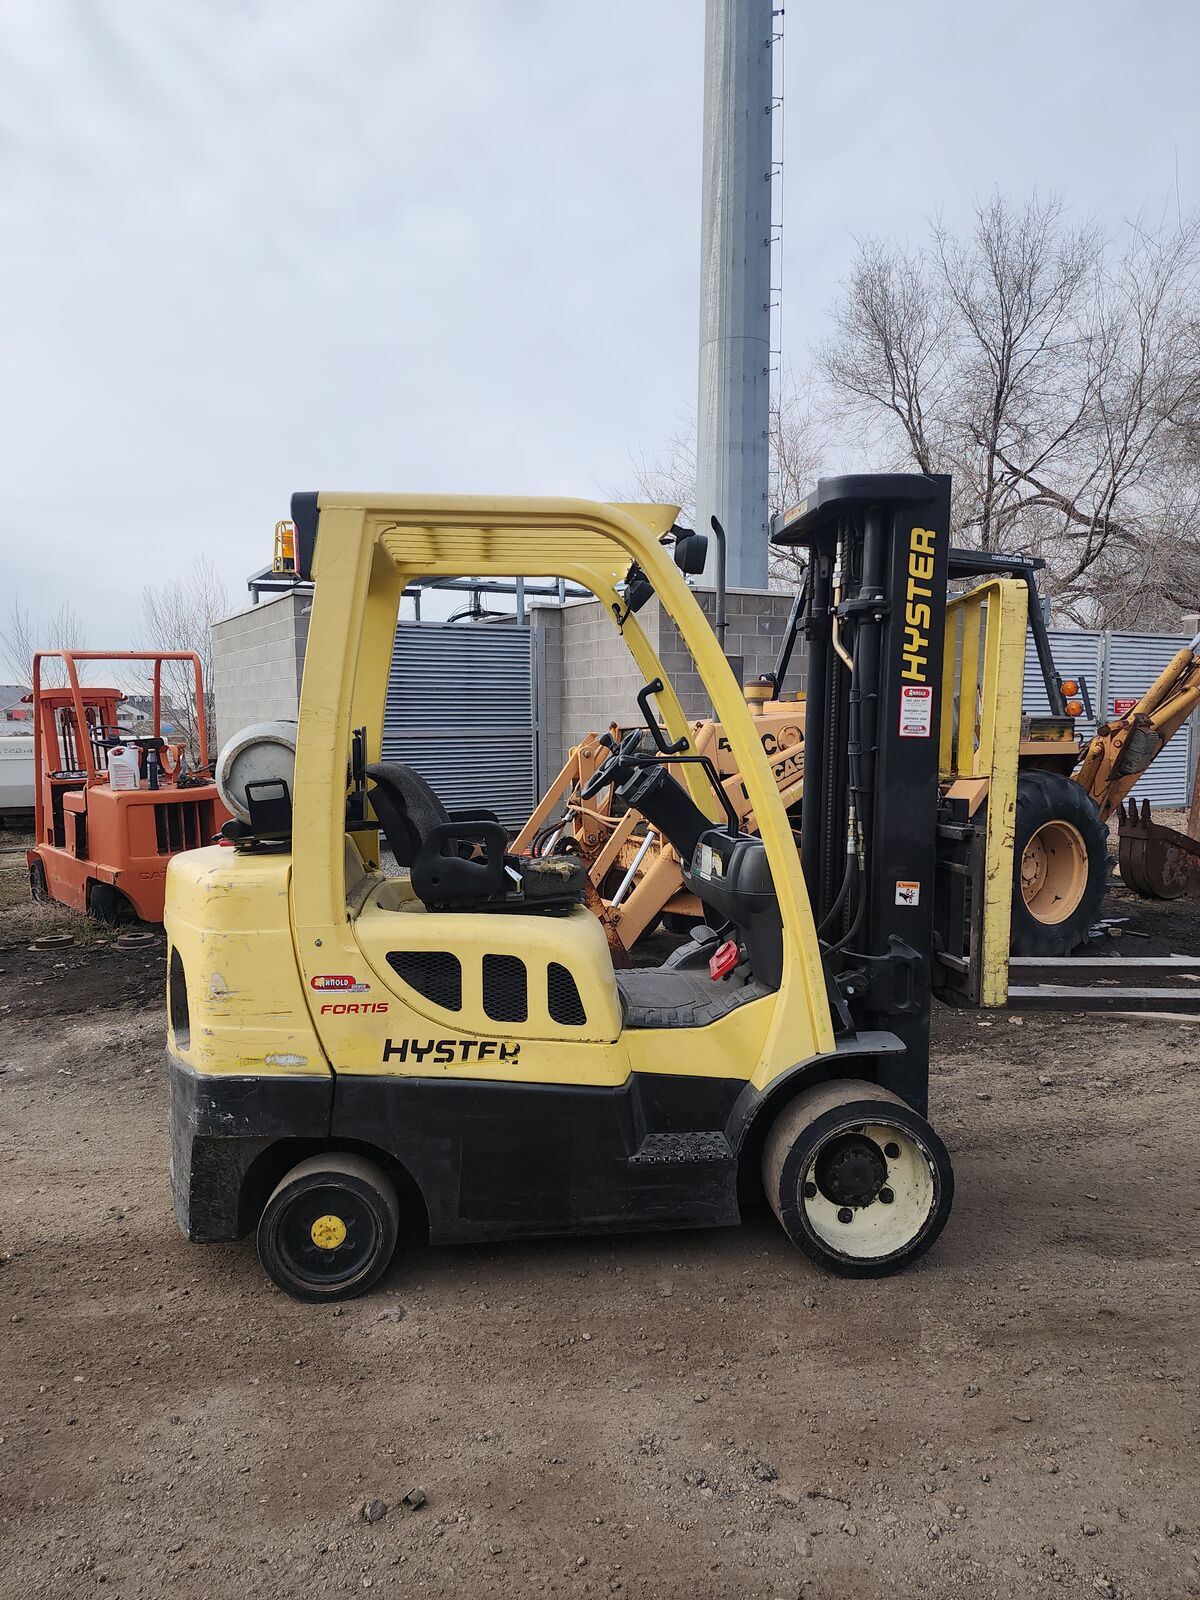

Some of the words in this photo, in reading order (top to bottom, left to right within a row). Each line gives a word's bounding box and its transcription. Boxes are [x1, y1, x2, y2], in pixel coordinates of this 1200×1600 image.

[991, 555, 1023, 564] construction
[901, 527, 936, 682] HYSTER
[773, 752, 805, 782] CAS
[320, 1002, 389, 1015] FORTIS
[382, 1038, 521, 1064] HYSTER
